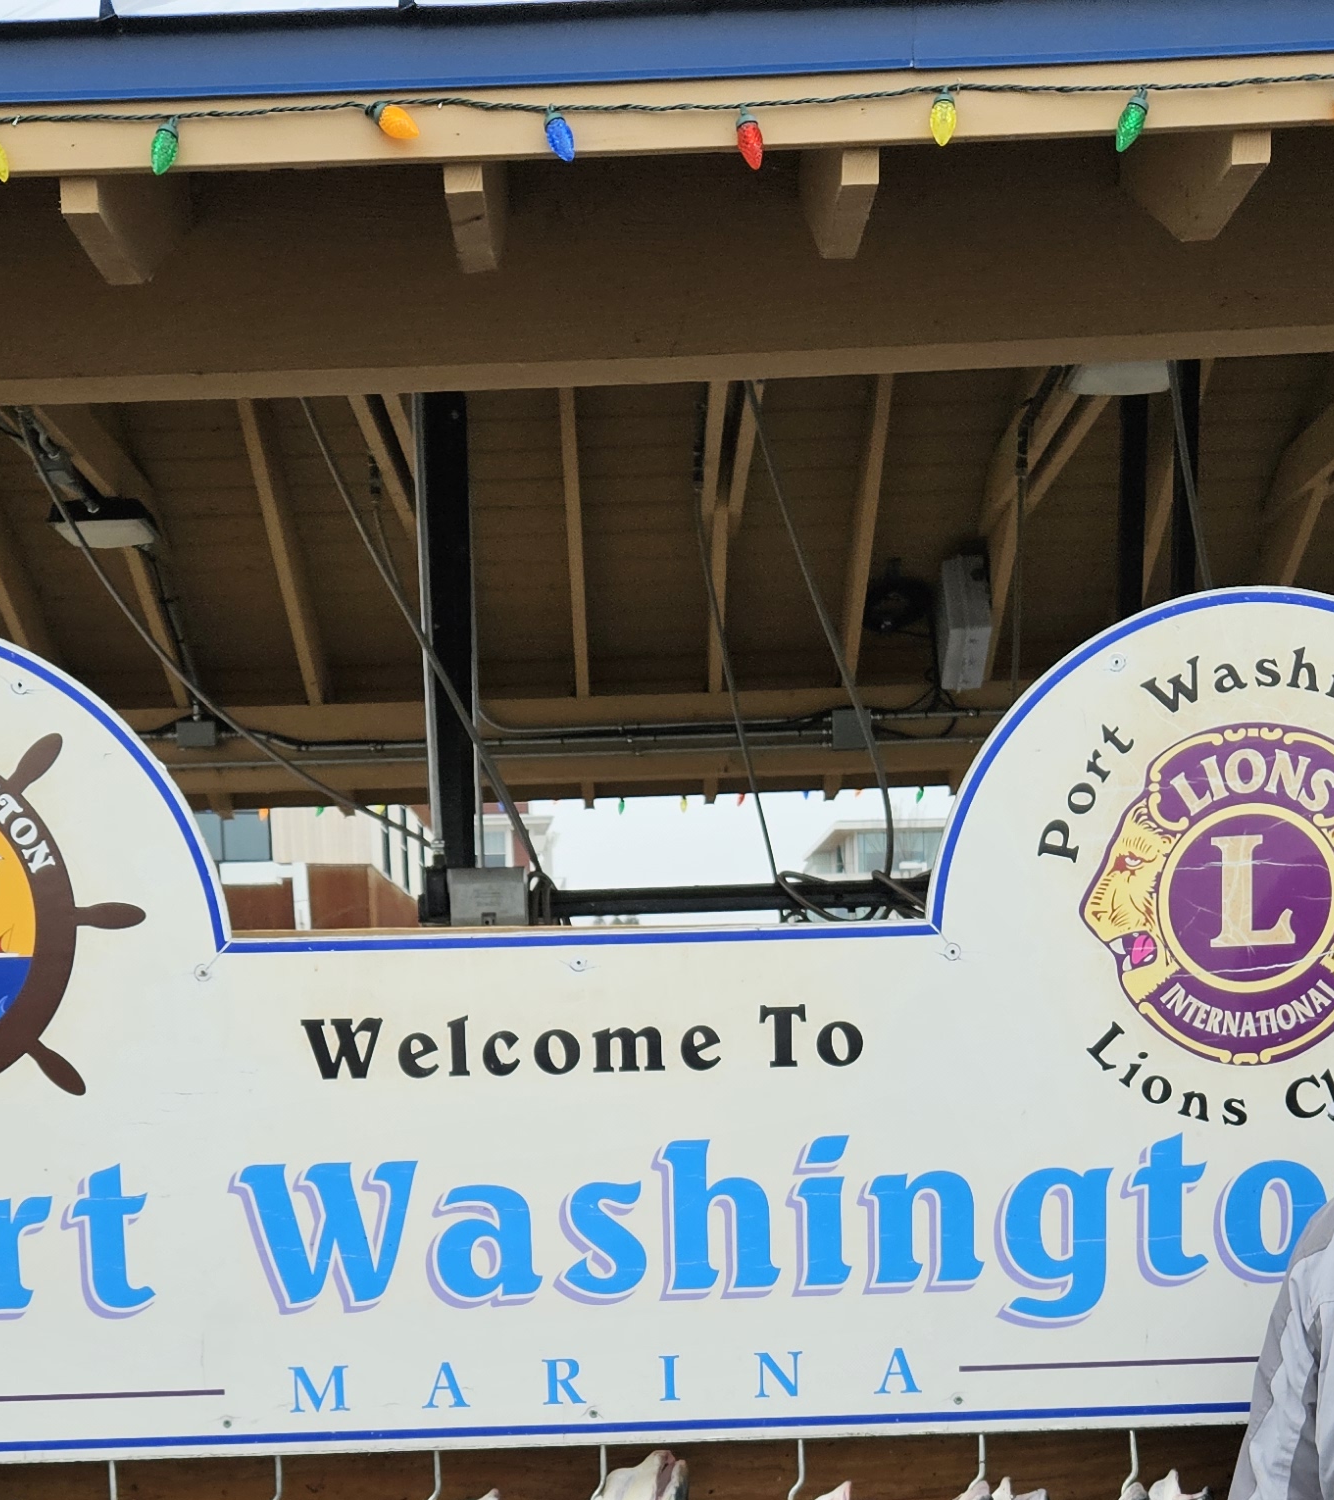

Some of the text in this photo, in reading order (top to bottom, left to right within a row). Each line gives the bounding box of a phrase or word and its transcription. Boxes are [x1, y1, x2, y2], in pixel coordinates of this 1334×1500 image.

[1037, 723, 1135, 862] Port
[1210, 833, 1296, 947] L
[300, 1003, 865, 1080] Welcome To
[1086, 1021, 1247, 1126] Lions
[290, 1347, 922, 1413] MARINA
